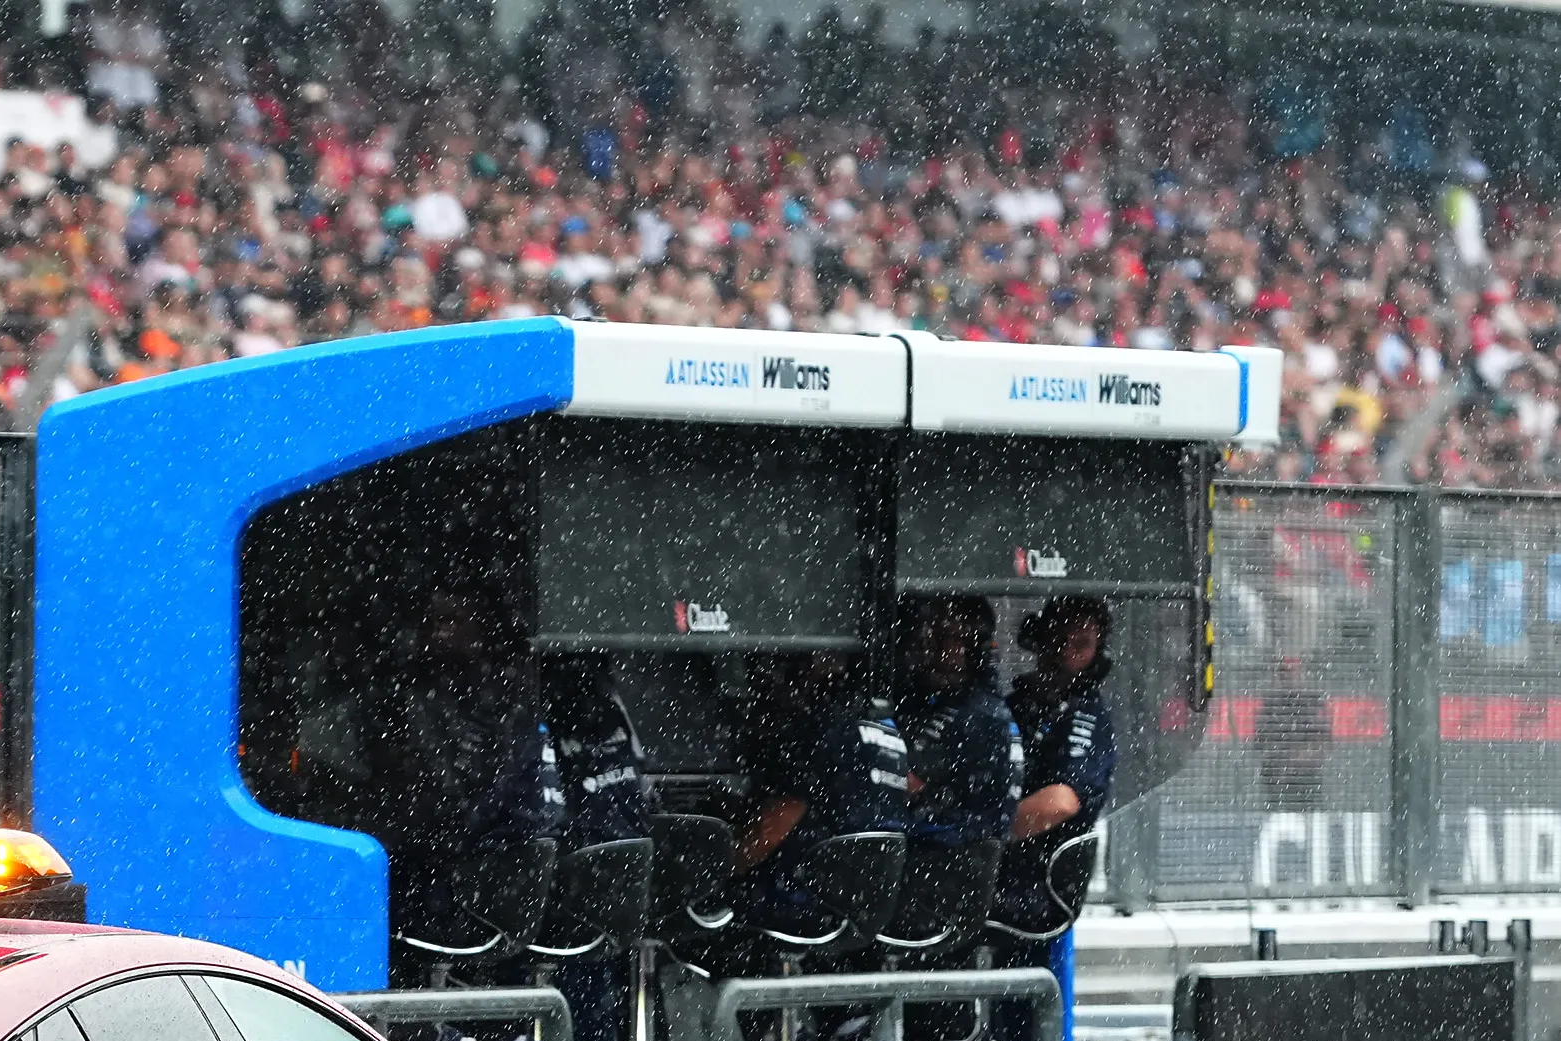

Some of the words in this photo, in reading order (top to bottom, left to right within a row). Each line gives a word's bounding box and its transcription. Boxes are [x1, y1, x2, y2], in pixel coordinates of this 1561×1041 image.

[678, 359, 749, 388] ATLASSIAN
[1021, 375, 1087, 402] ATLASSIAN
[1099, 373, 1161, 406] Williams
